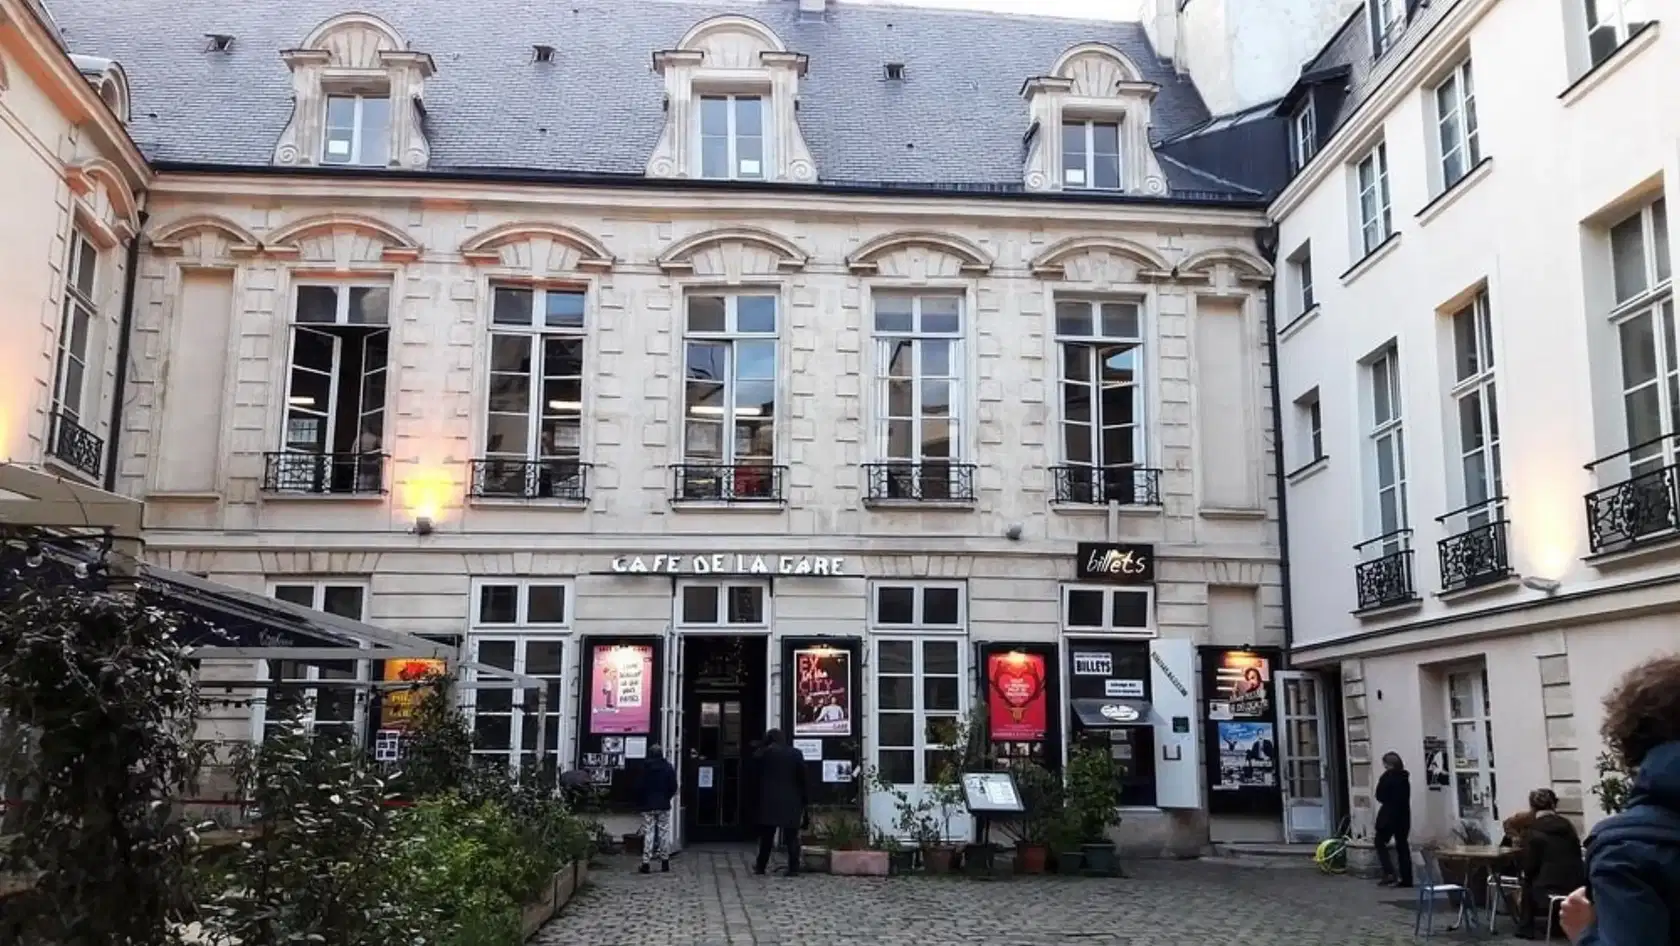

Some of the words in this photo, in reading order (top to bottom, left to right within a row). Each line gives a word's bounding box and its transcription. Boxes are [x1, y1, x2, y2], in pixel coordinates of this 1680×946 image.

[612, 554, 682, 573] CAFE
[693, 554, 725, 573] DE
[736, 554, 769, 573] LA
[778, 555, 844, 575] GARE
[1086, 549, 1146, 574] billets
[799, 656, 819, 671] EX
[1076, 660, 1112, 673] BILLETS
